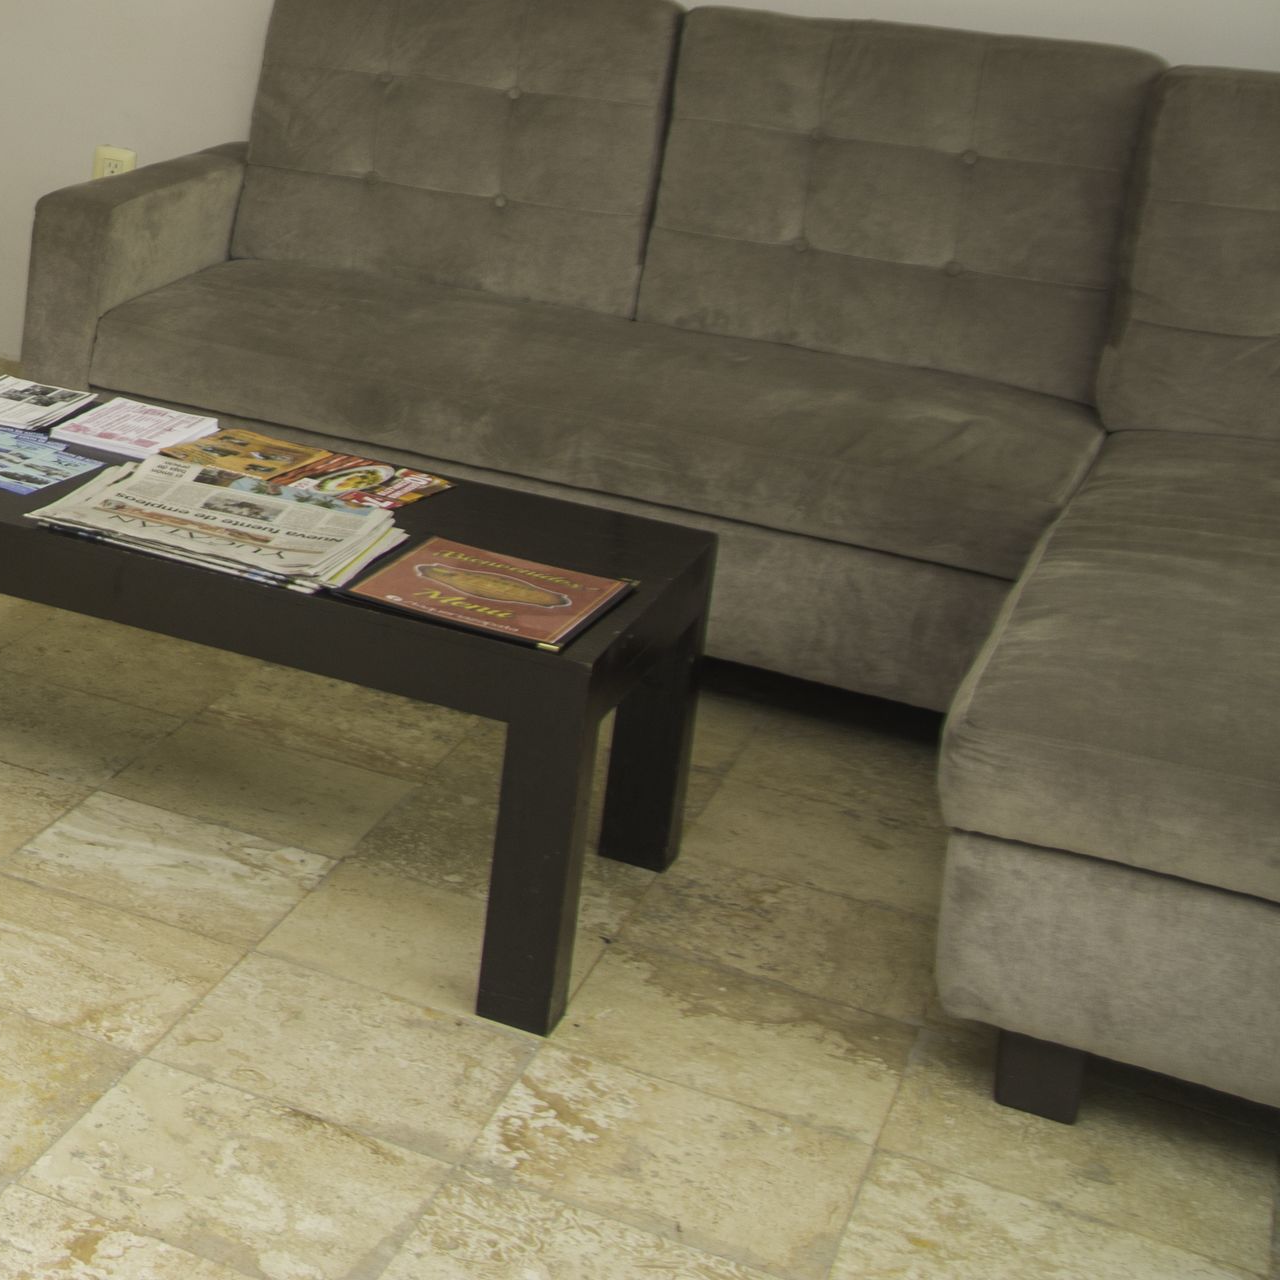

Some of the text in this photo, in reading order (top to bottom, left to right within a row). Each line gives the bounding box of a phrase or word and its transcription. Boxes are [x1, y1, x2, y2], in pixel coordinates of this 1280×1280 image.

[115, 492, 345, 543] Nueva fuente de empleos
